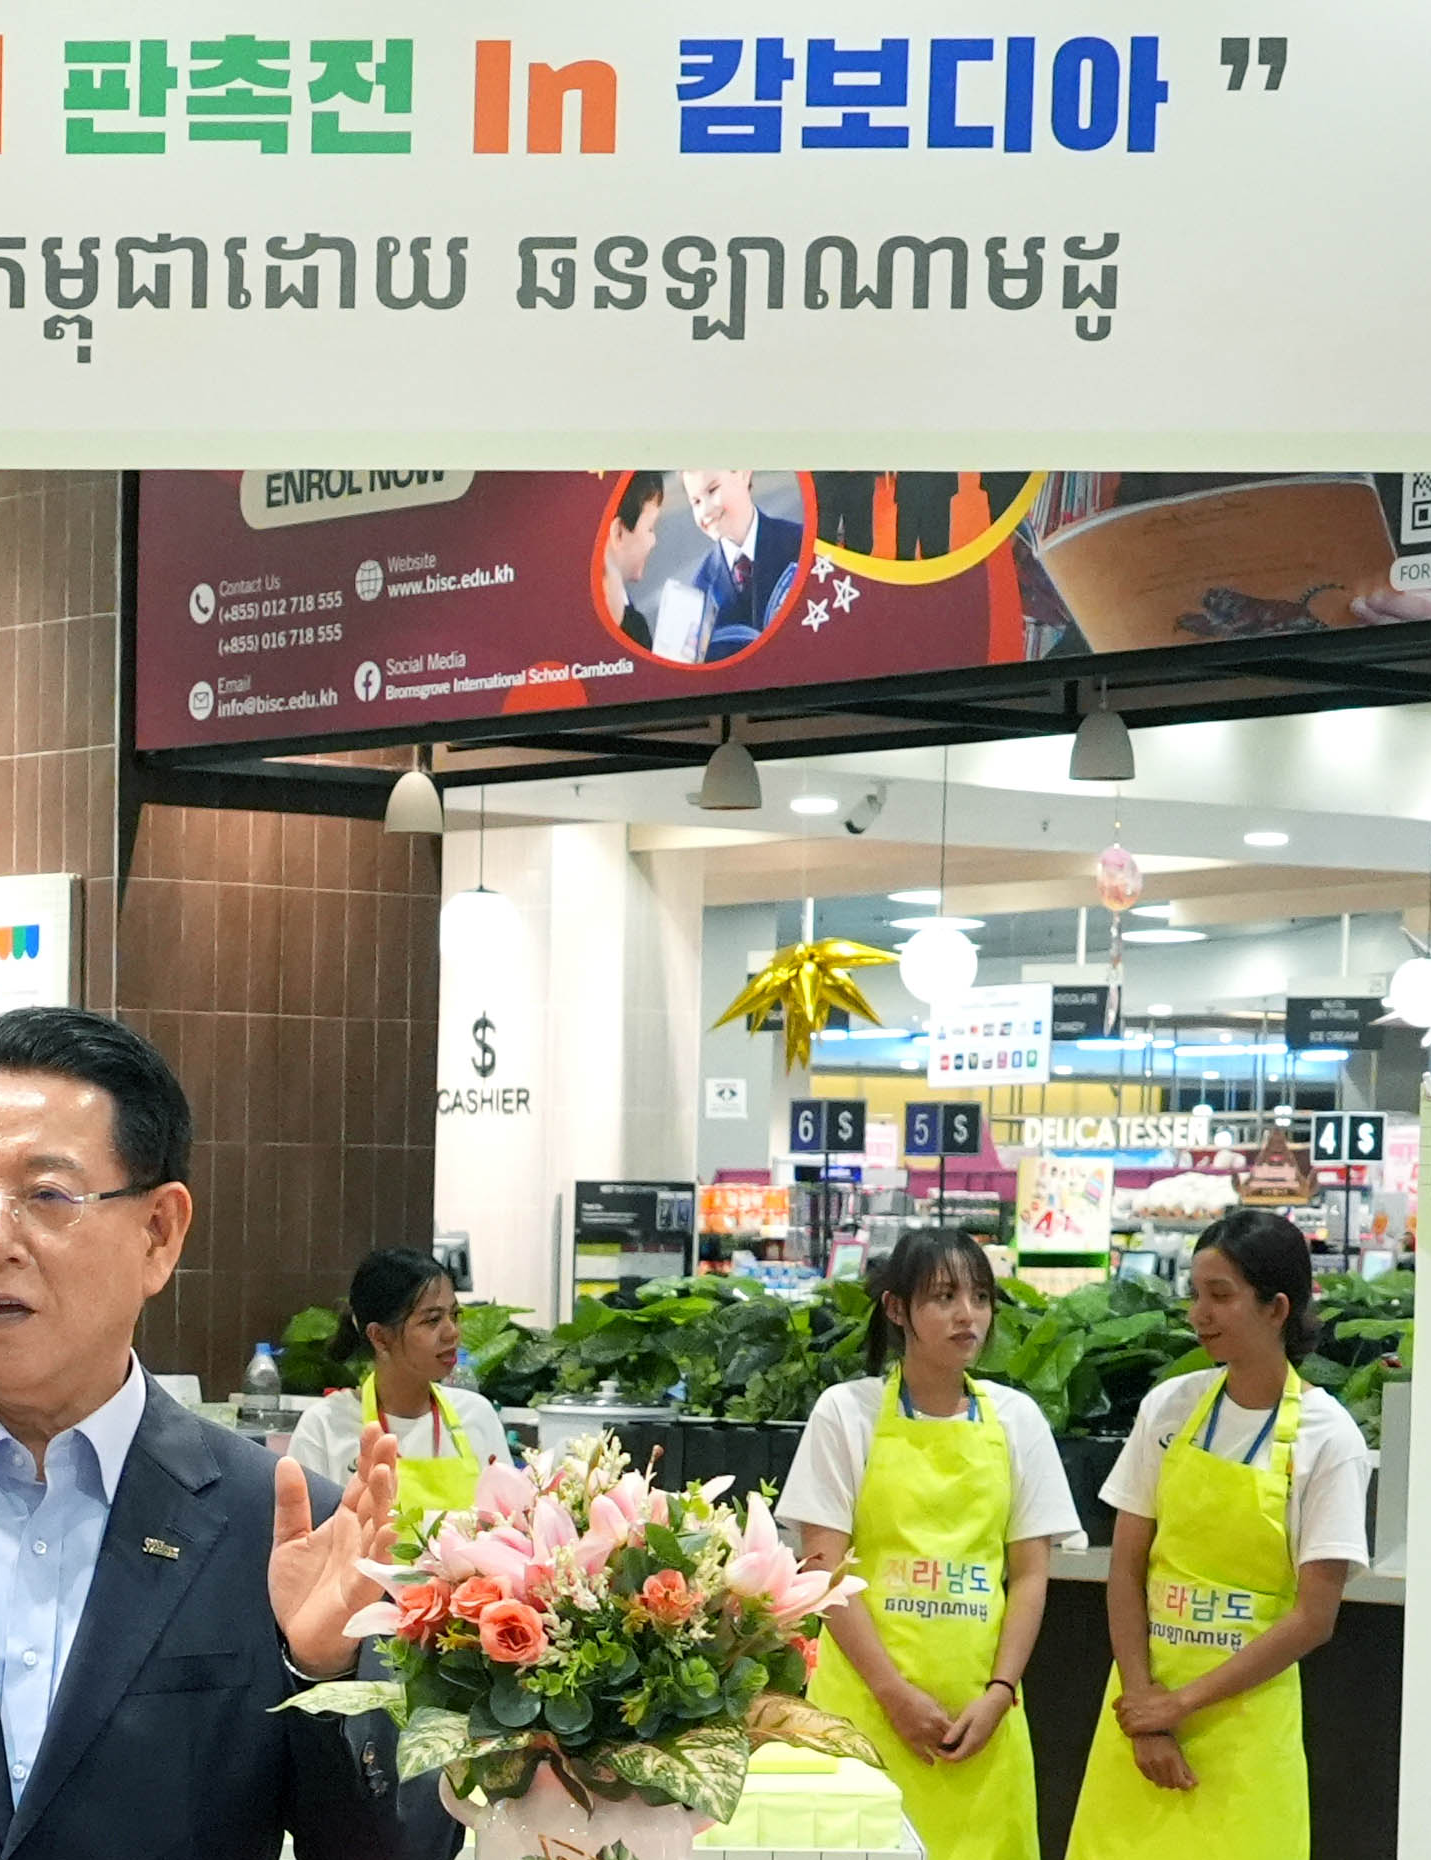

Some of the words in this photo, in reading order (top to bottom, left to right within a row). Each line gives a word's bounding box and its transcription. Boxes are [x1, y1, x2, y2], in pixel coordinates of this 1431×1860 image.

[63, 35, 413, 155] 판촉전
[472, 39, 618, 154] In
[675, 36, 1169, 154] 캄보디아
[387, 552, 436, 574] Website
[1399, 562, 1431, 581] FOR
[218, 577, 262, 598] Contact
[264, 574, 282, 591] Us
[387, 564, 515, 599] www.bisc.edu.kh
[218, 601, 259, 623] (+855)
[261, 598, 287, 618] 012
[290, 594, 315, 614] 718
[318, 590, 343, 610] 555
[218, 634, 259, 656] (+855)
[261, 631, 287, 651] 016
[290, 627, 314, 646] 718
[317, 623, 343, 642] 555
[386, 655, 423, 676] Social
[427, 651, 466, 672] Media
[453, 669, 526, 694] International
[529, 663, 569, 683] School
[571, 657, 634, 680] Cambodia
[217, 674, 251, 695] Email
[217, 687, 338, 718] info@bisc.edu.kh
[437, 1088, 532, 1115] CASHIER
[798, 1110, 814, 1143] 6
[913, 1115, 929, 1146] 5
[1024, 1115, 1210, 1148] DELICATESSEN
[1318, 1120, 1338, 1155] 4
